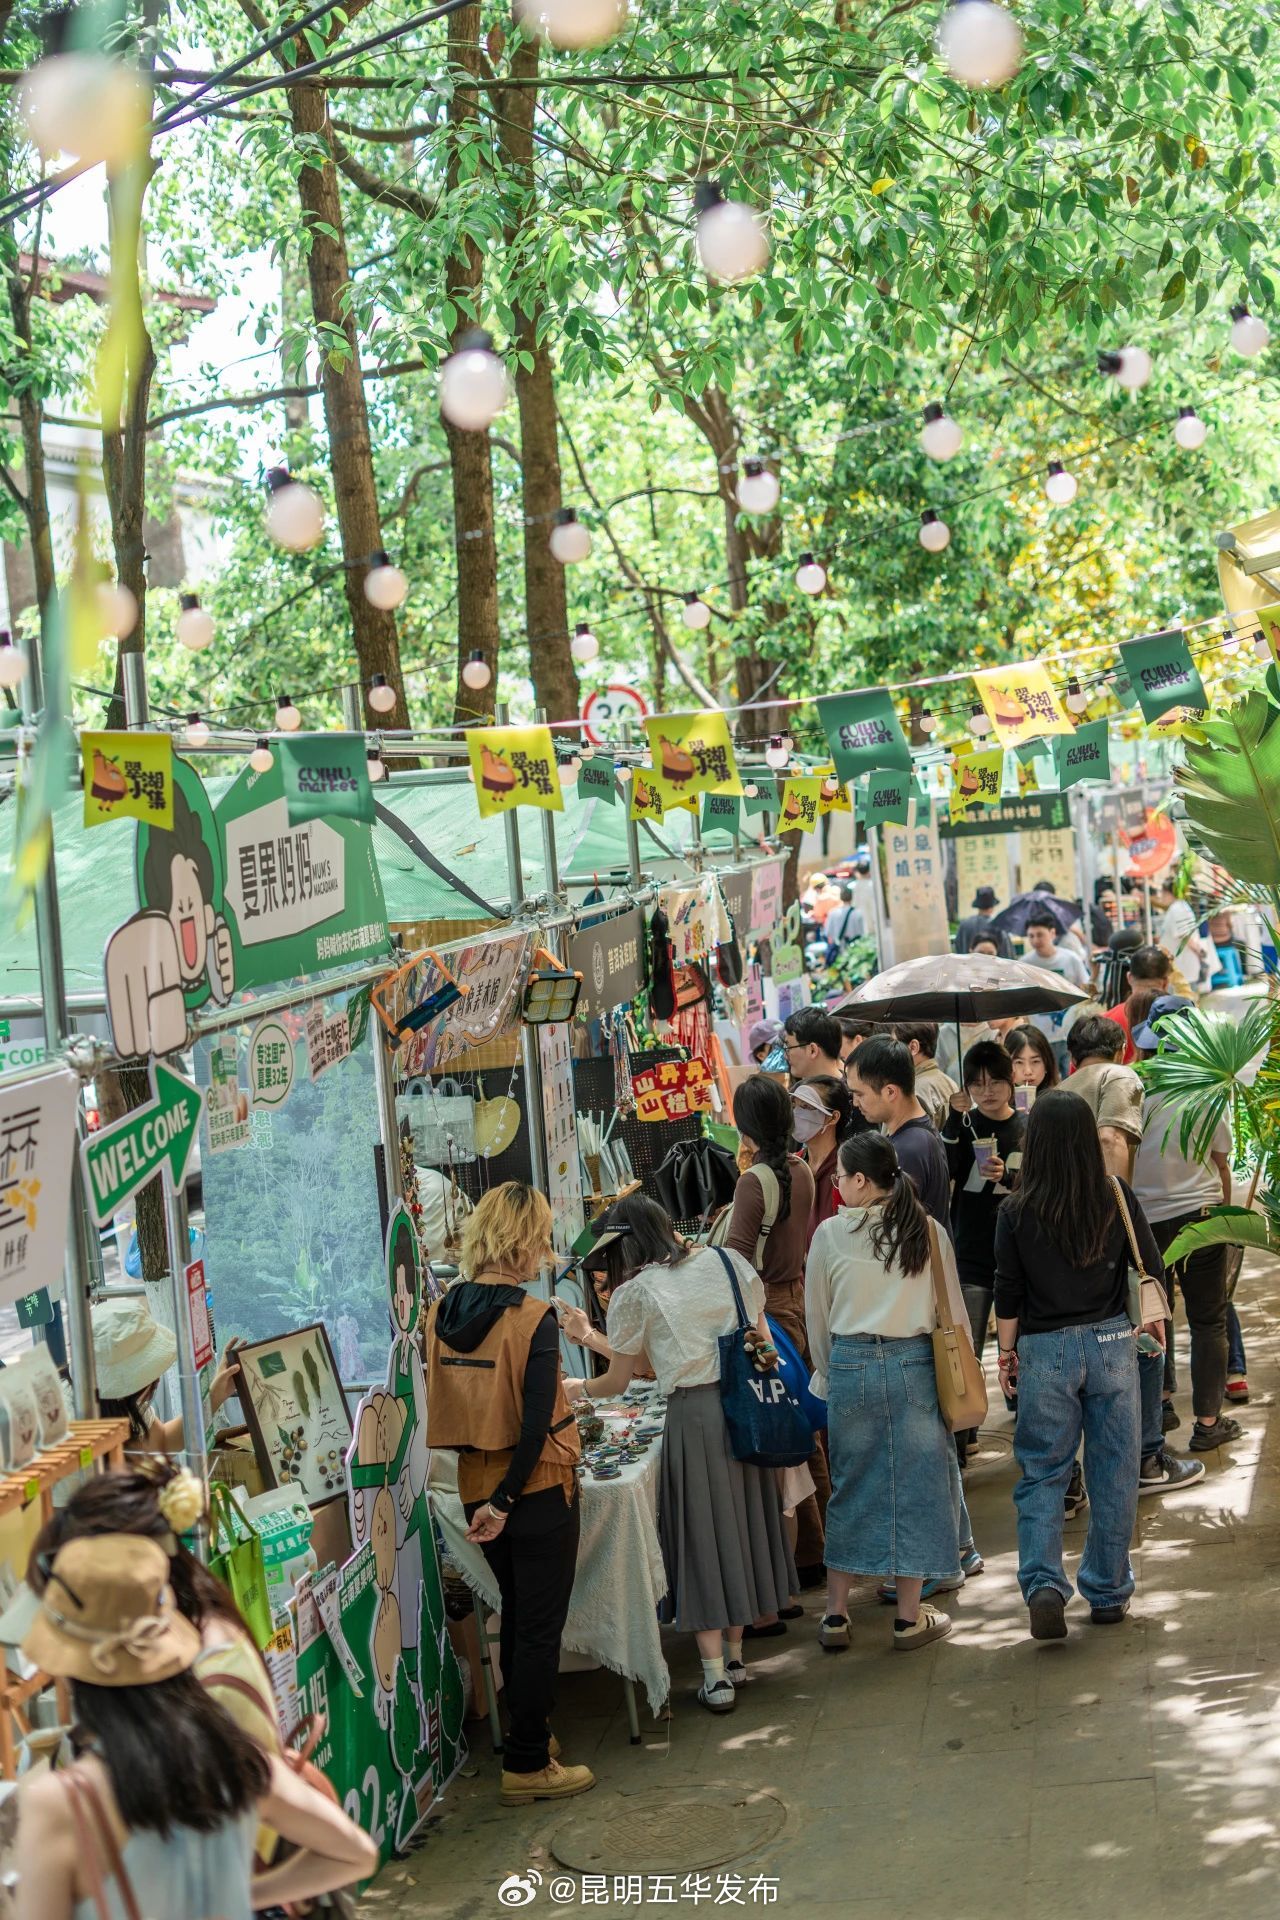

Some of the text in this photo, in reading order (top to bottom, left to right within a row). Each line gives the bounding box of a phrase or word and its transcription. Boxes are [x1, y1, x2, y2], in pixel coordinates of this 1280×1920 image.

[1140, 662, 1182, 682] CUIHU
[1143, 671, 1191, 692] market
[839, 719, 885, 740] CUIHU
[841, 730, 893, 750] market
[298, 767, 352, 781] CUIHU
[298, 778, 358, 793] market
[239, 833, 313, 920] 夏果妈妈
[635, 1061, 706, 1094] 山丹丹
[641, 1084, 711, 1114] 山楂美
[91, 1098, 191, 1200] WELCOME
[1097, 1332, 1116, 1343] BABY
